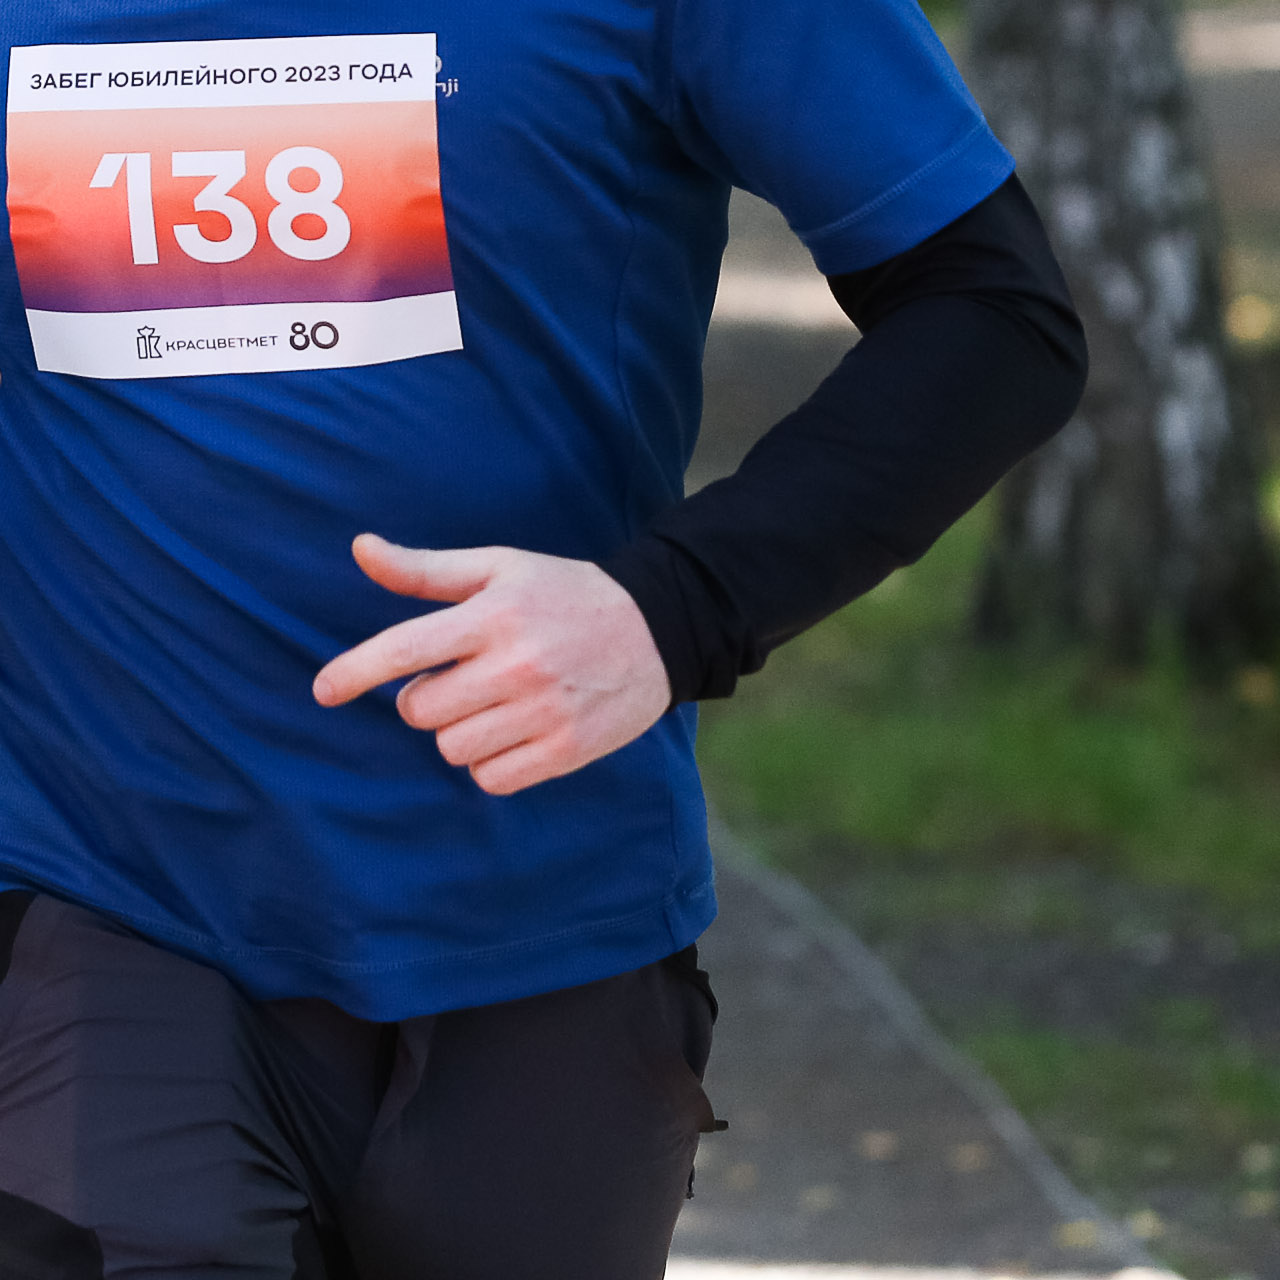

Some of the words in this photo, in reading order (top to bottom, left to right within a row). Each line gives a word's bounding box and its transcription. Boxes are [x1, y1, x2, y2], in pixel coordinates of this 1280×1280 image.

[30, 72, 102, 90] ЗАБЕГ
[108, 65, 277, 88] ЮБИЛЕЙНОГО
[285, 65, 340, 83] 2023
[349, 63, 413, 83] ГОДА
[89, 146, 351, 265] 138
[166, 335, 278, 352] КРАСЦВЕТМЕТ
[289, 321, 339, 351] 80
